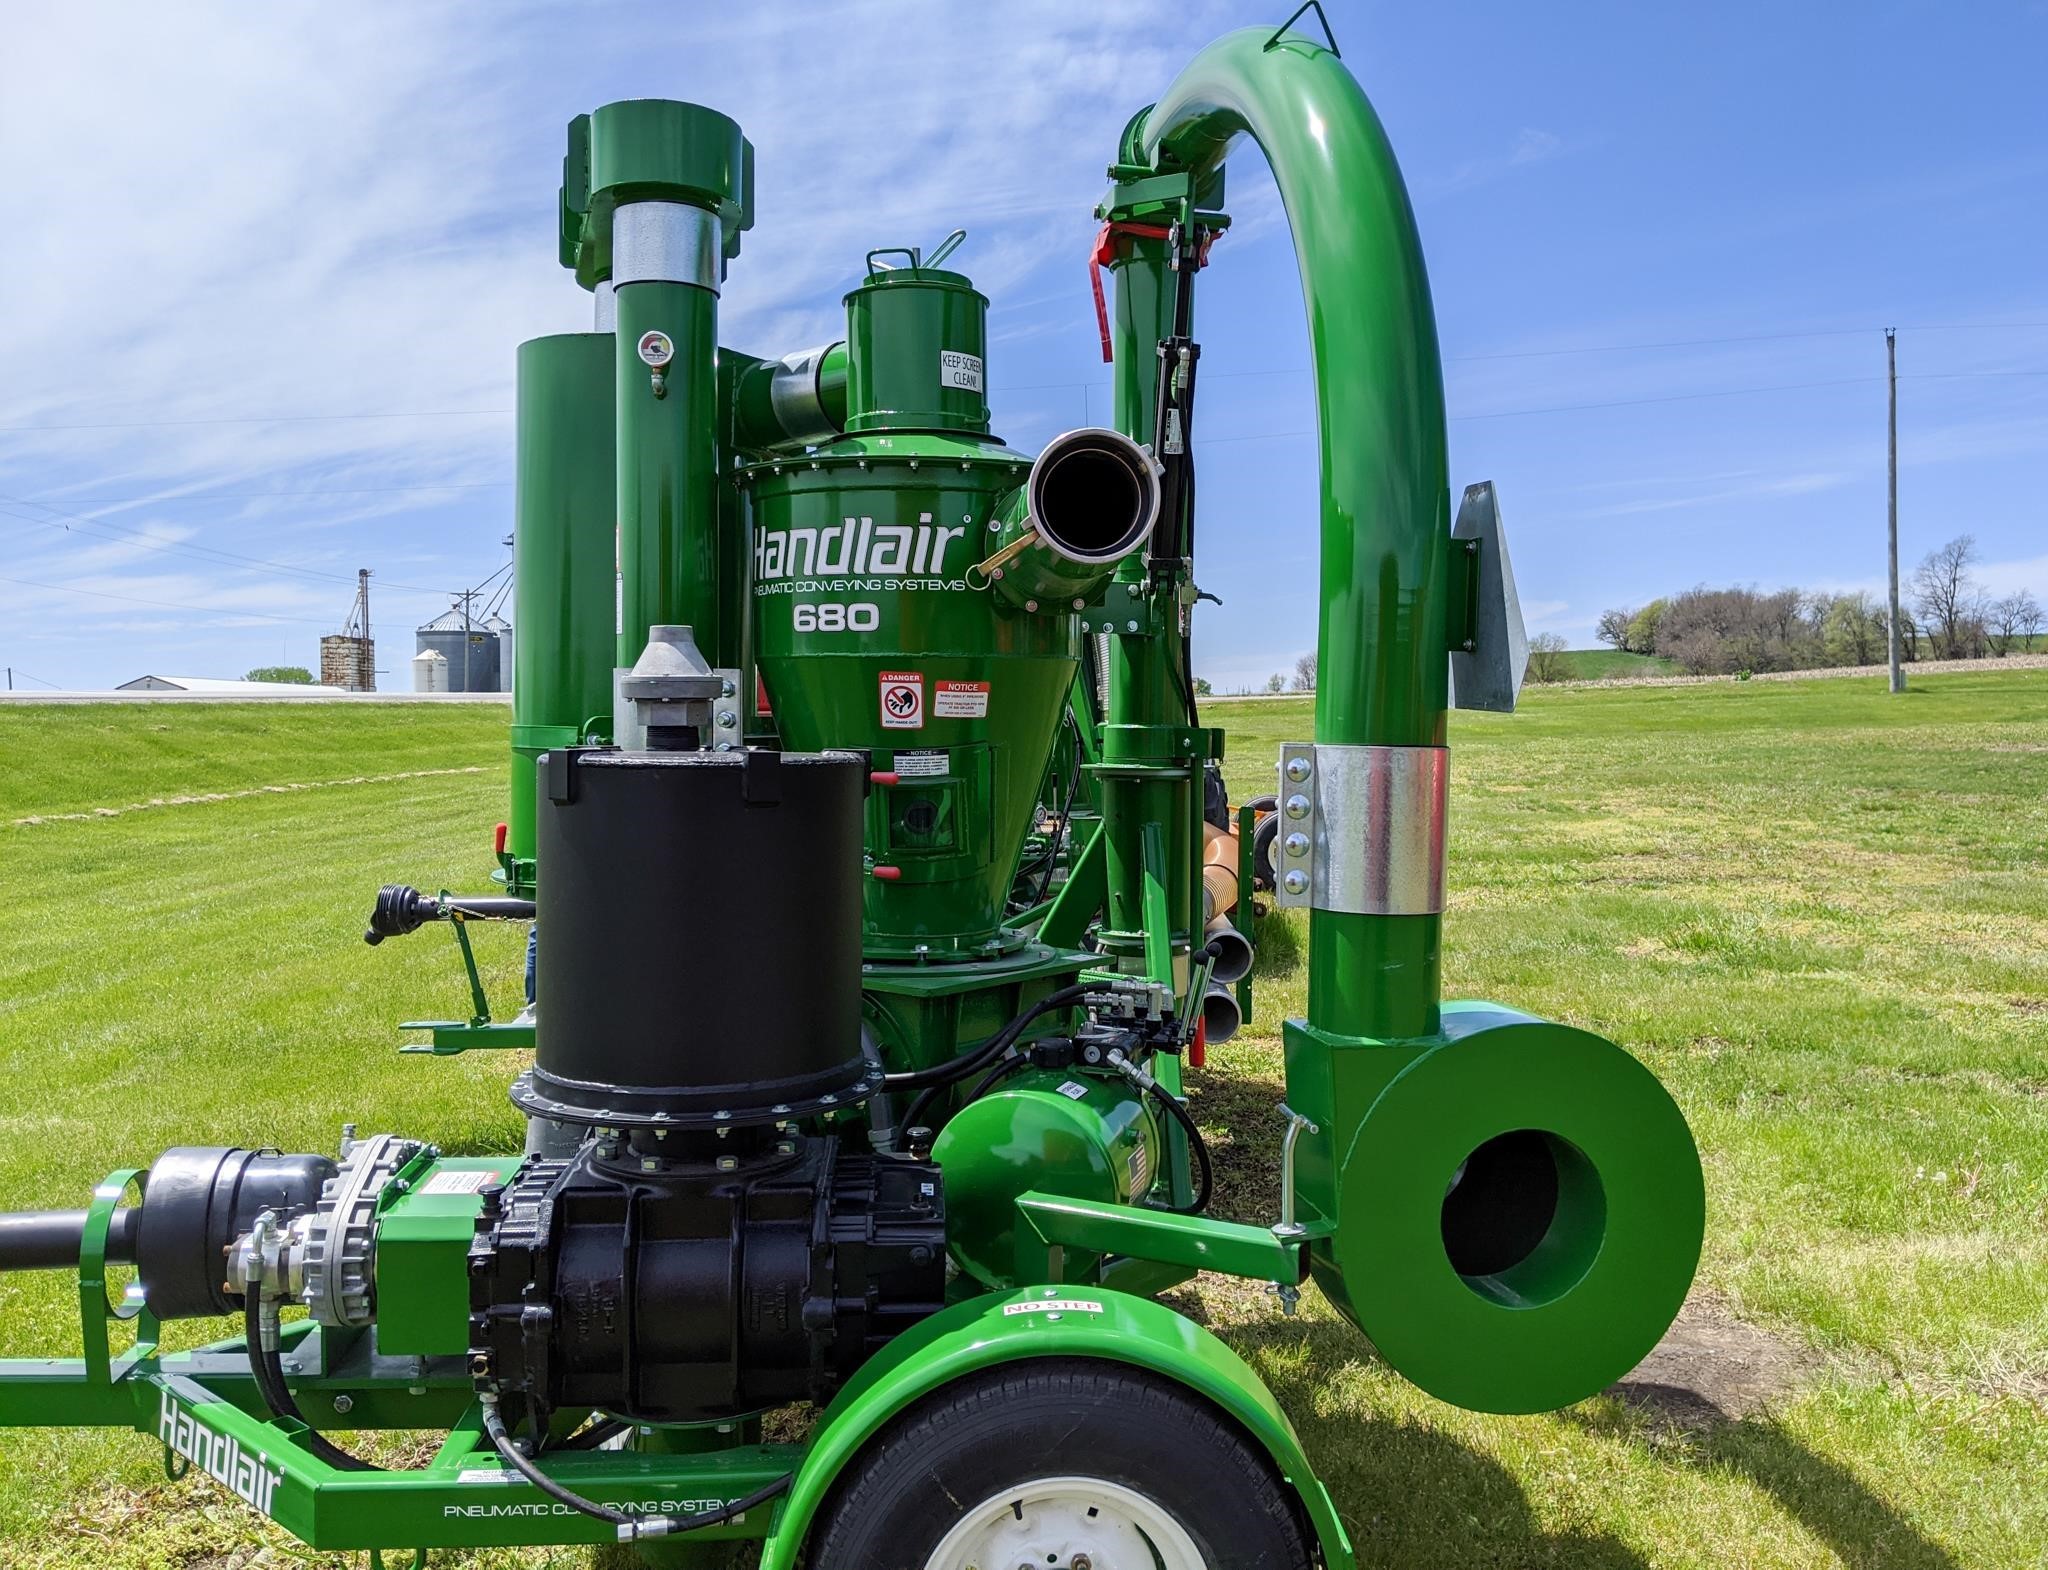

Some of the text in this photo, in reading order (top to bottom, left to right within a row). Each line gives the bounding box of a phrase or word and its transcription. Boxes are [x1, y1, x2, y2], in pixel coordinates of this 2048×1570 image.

[943, 354, 982, 374] KEEP SCREEN
[954, 371, 977, 388] CLEAN!
[795, 580, 882, 593] CONVEYING
[884, 579, 966, 591] SYSTEMS
[793, 602, 880, 632] 680
[948, 683, 979, 691] NOTICE
[1007, 1301, 1099, 1313] NO STEP
[444, 1504, 549, 1517] PNEUMATIC
[661, 1499, 742, 1512] SYSTEM
